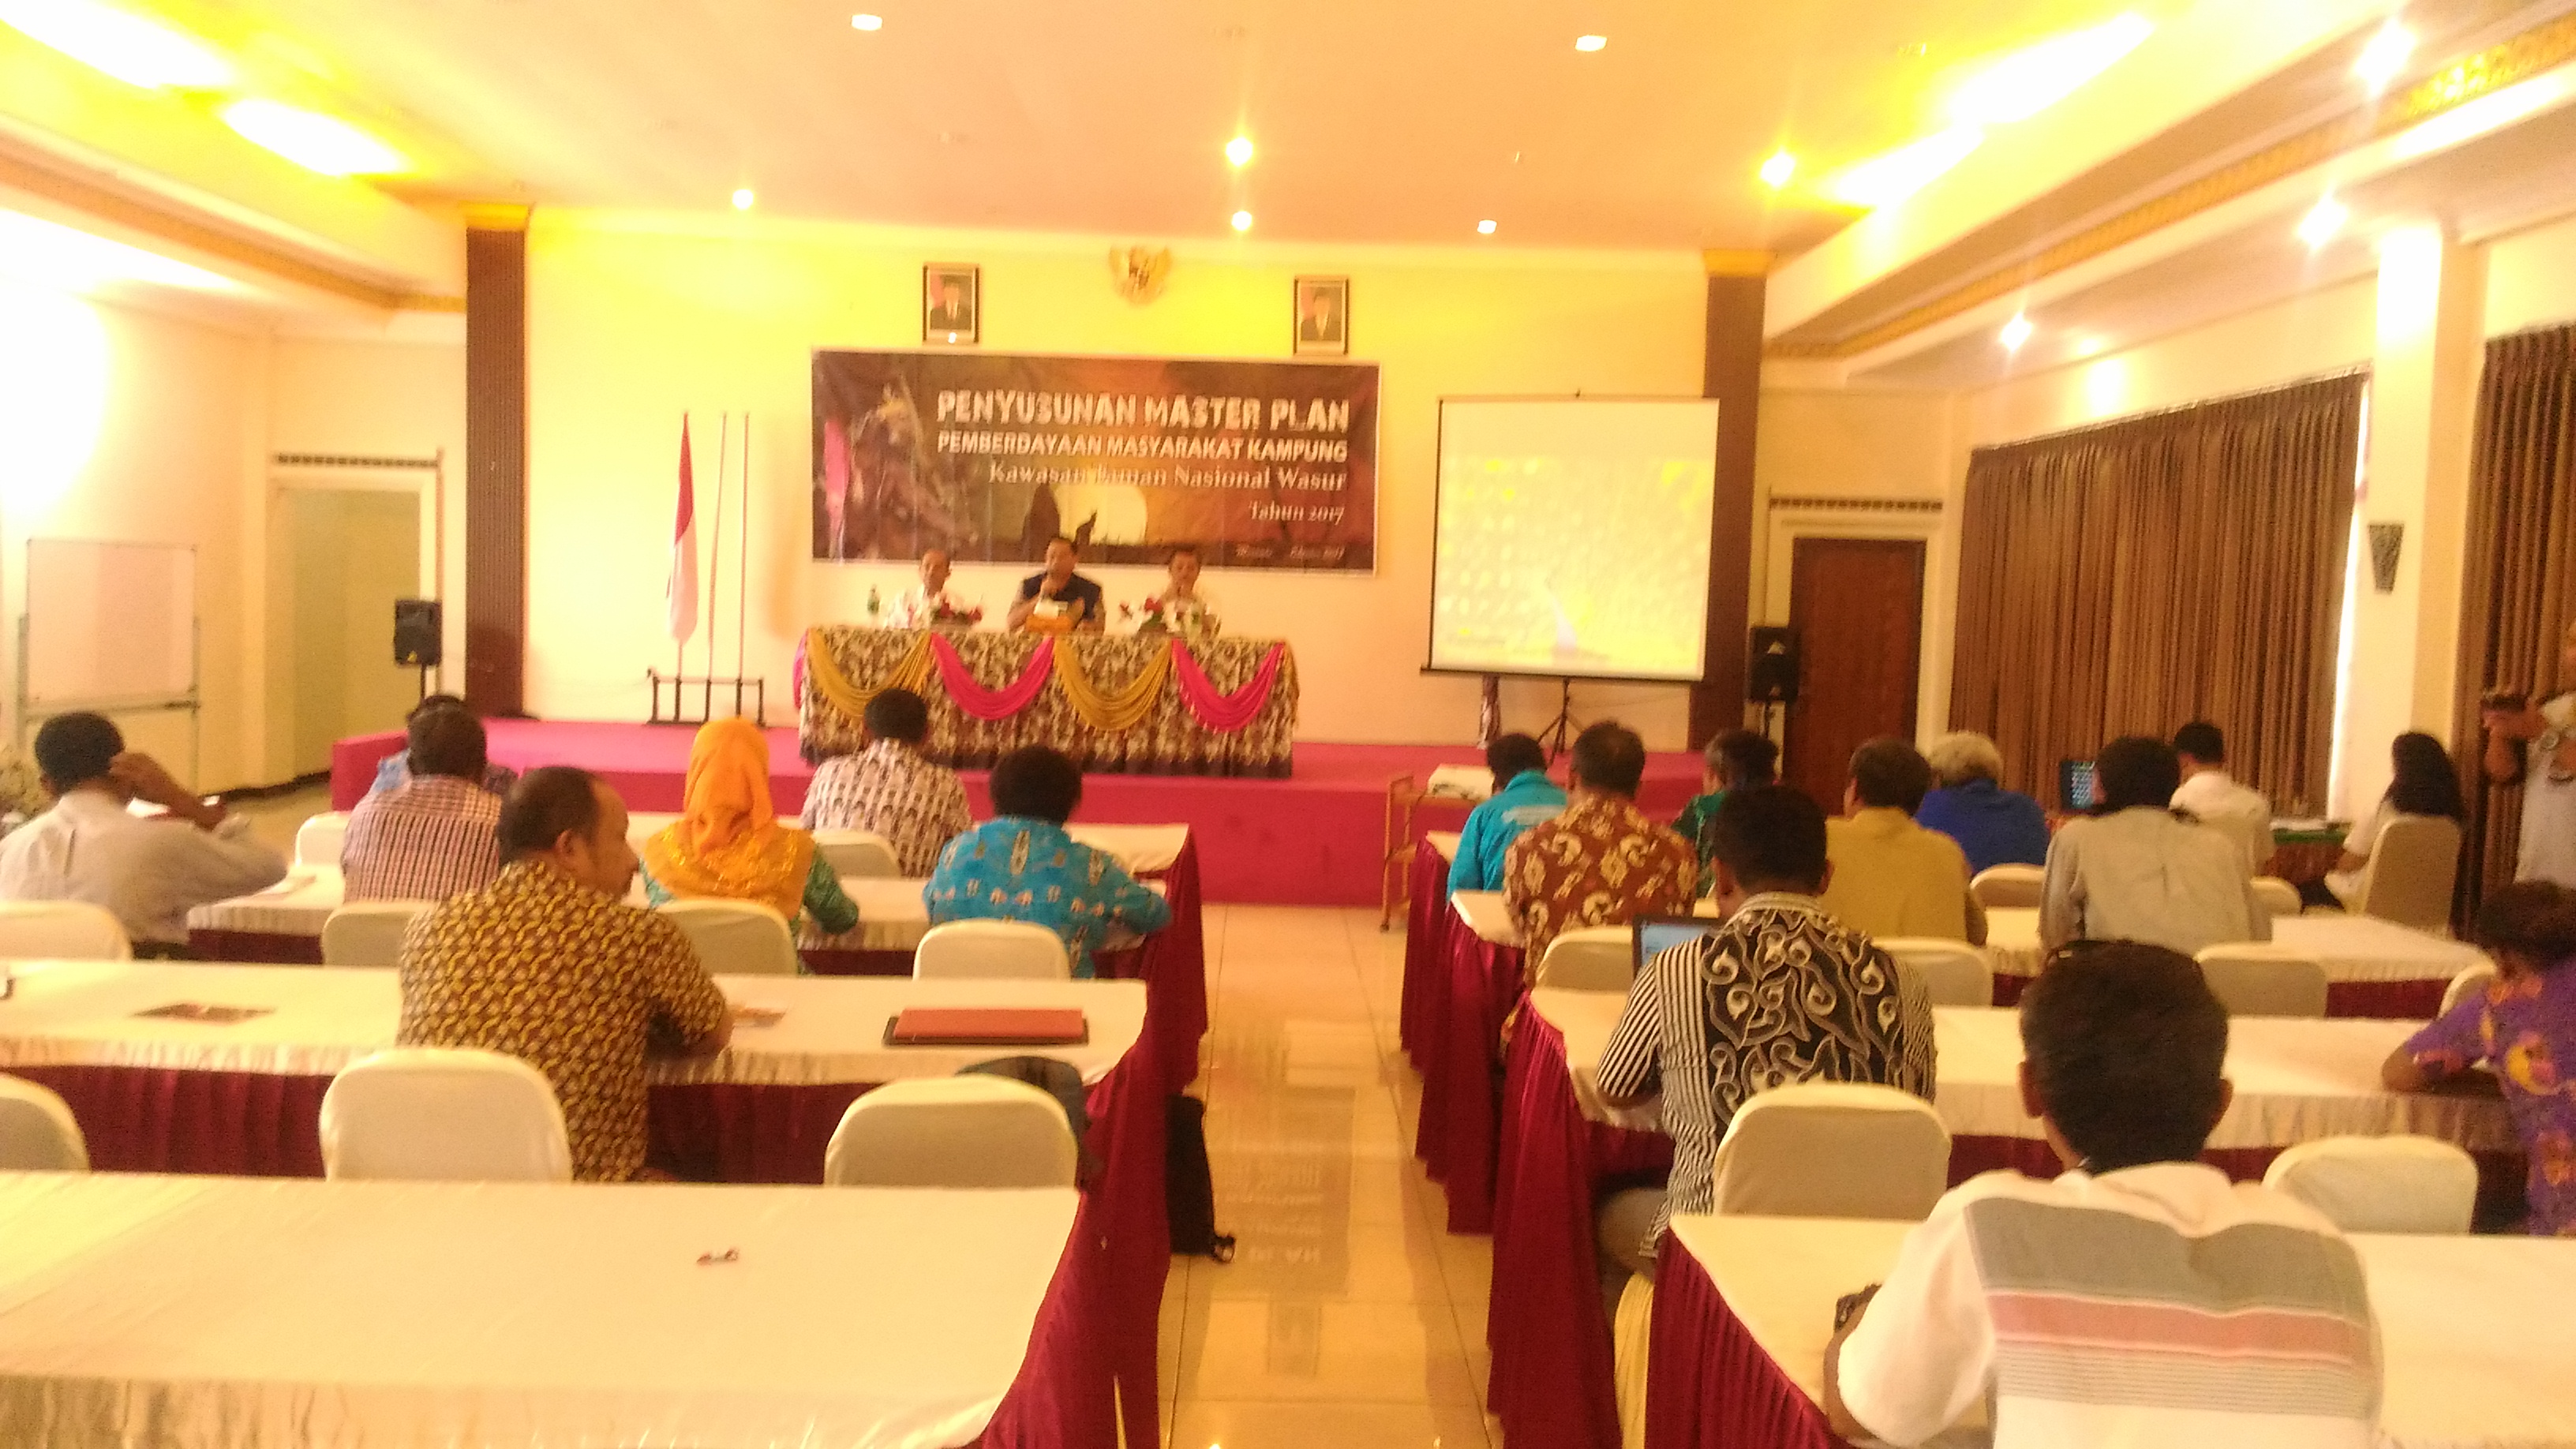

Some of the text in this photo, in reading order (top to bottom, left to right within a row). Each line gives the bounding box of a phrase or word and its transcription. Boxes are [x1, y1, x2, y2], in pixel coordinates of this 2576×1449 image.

[937, 389, 1350, 433] PENYUSUNAN MASTER PLAN
[937, 429, 1348, 462] PEMBERDAYAAN MASYARAKAT KAMPUNG
[989, 460, 1087, 484] Kawasan
[1174, 464, 1271, 489] Nasional
[1277, 466, 1347, 491] Wasur
[1249, 500, 1345, 526] Tahun 2017
